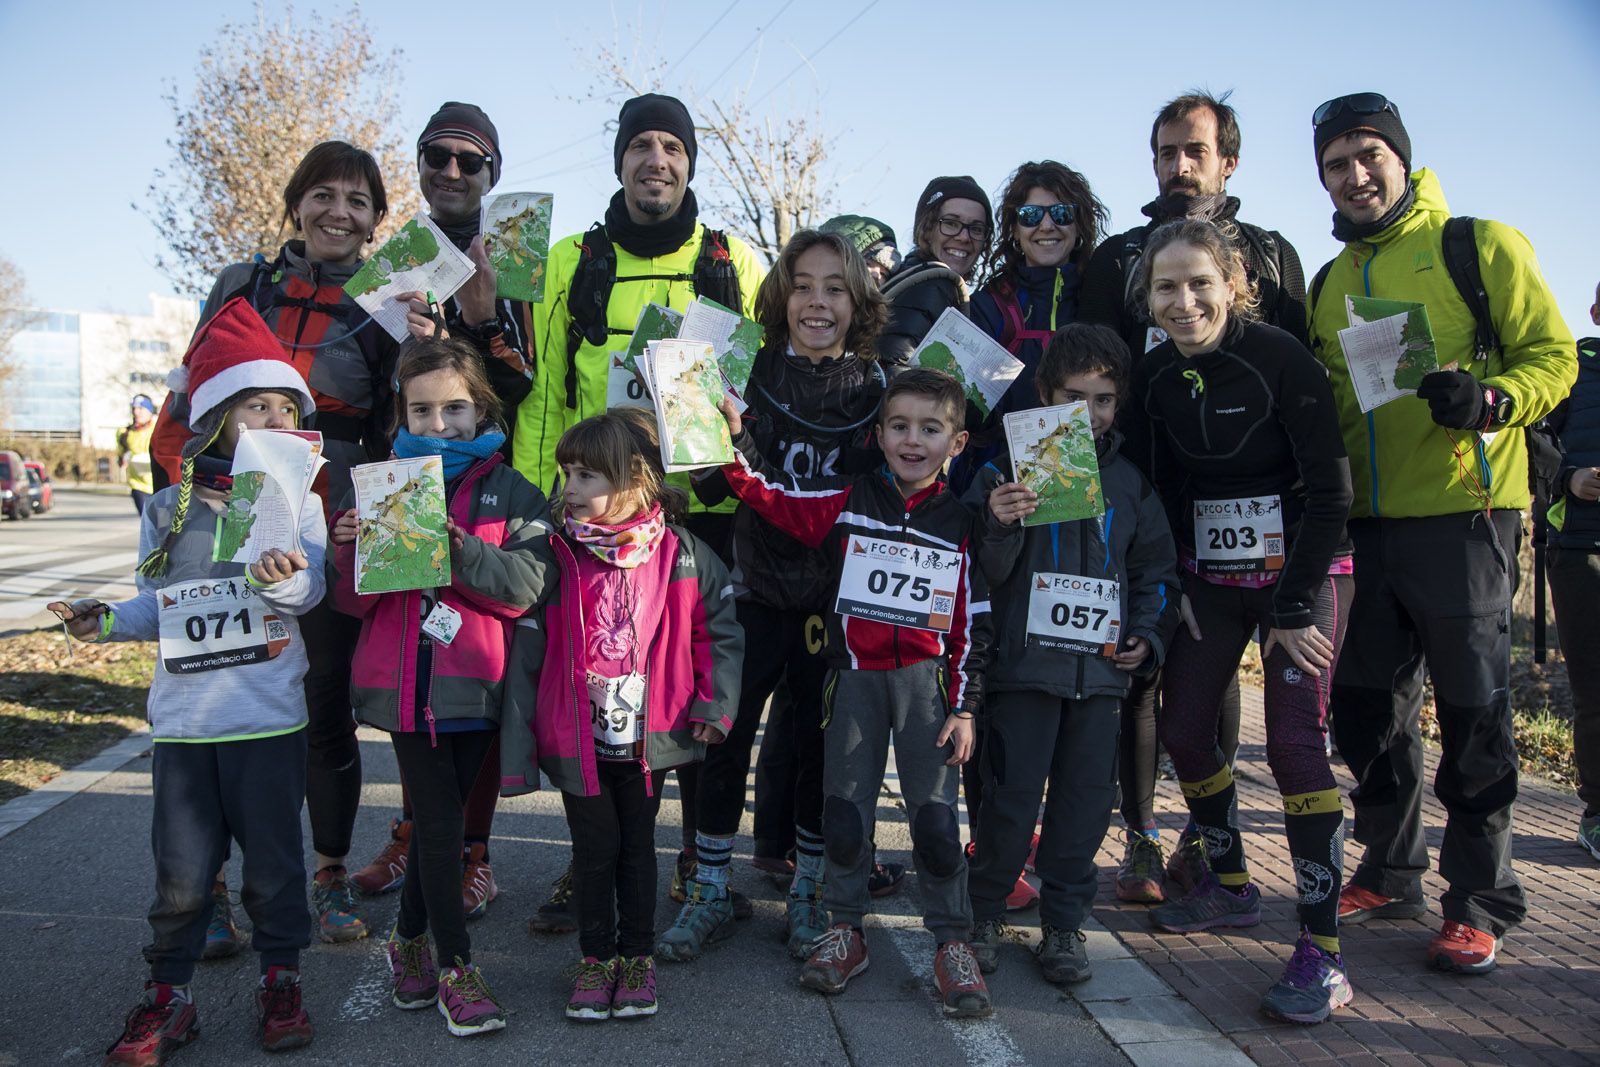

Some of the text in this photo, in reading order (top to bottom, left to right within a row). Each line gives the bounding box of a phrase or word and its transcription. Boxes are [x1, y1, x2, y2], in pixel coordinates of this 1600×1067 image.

[1207, 526, 1258, 550] 203
[870, 542, 908, 557] FCOC
[1206, 563, 1257, 571] www.orientacio.cat
[180, 583, 222, 600] FCOC
[867, 569, 931, 602] 075
[1054, 578, 1092, 592] FCOC
[851, 606, 917, 623] www.orientacio.cat
[1050, 602, 1109, 632] 057
[185, 607, 252, 643] 071
[1039, 640, 1099, 654] www.orientacio.cat
[180, 651, 257, 670] www.orientacio.cat
